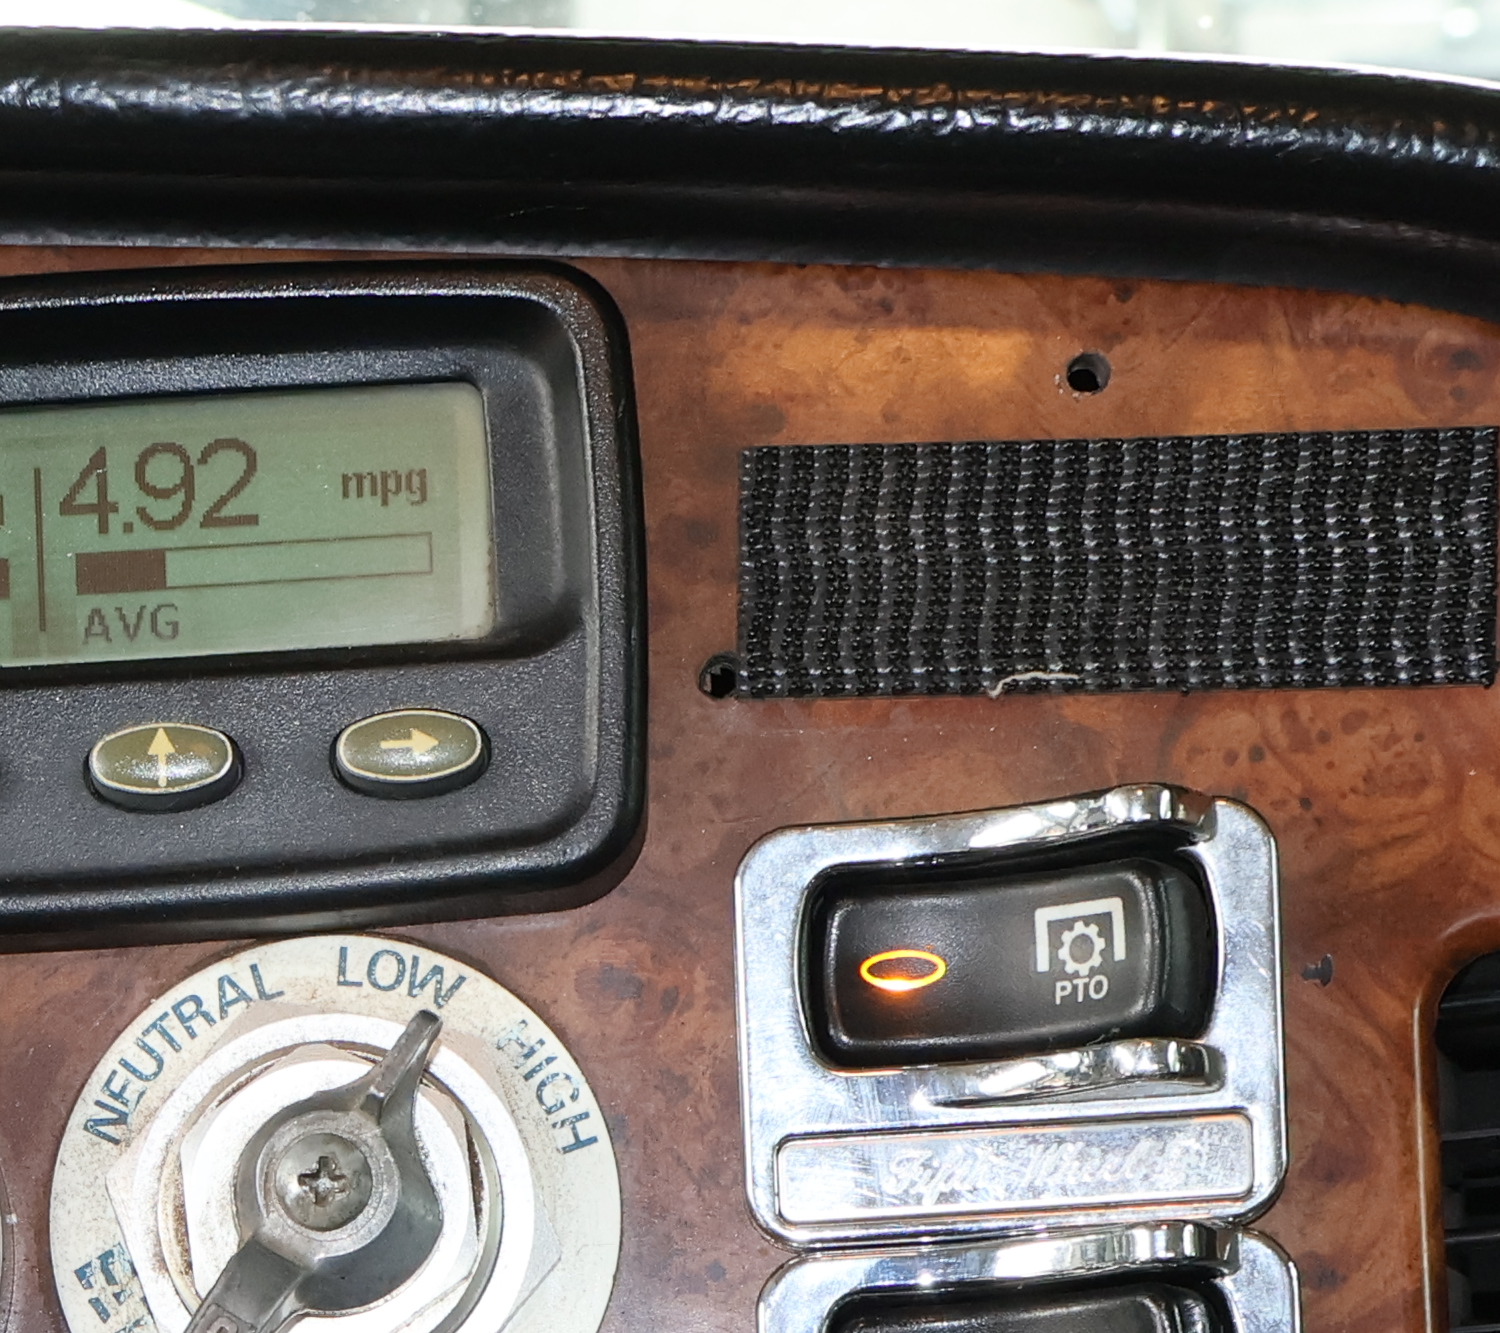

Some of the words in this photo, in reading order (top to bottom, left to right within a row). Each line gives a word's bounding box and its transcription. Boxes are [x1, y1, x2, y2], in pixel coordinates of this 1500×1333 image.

[58, 437, 260, 535] 4.92
[340, 464, 428, 508] mpg
[82, 604, 180, 645] AVG
[1055, 974, 1108, 1005] PTO
[82, 963, 285, 1146] NEUTRAL
[337, 946, 466, 1009] LOW
[496, 1019, 600, 1155] HIGH
